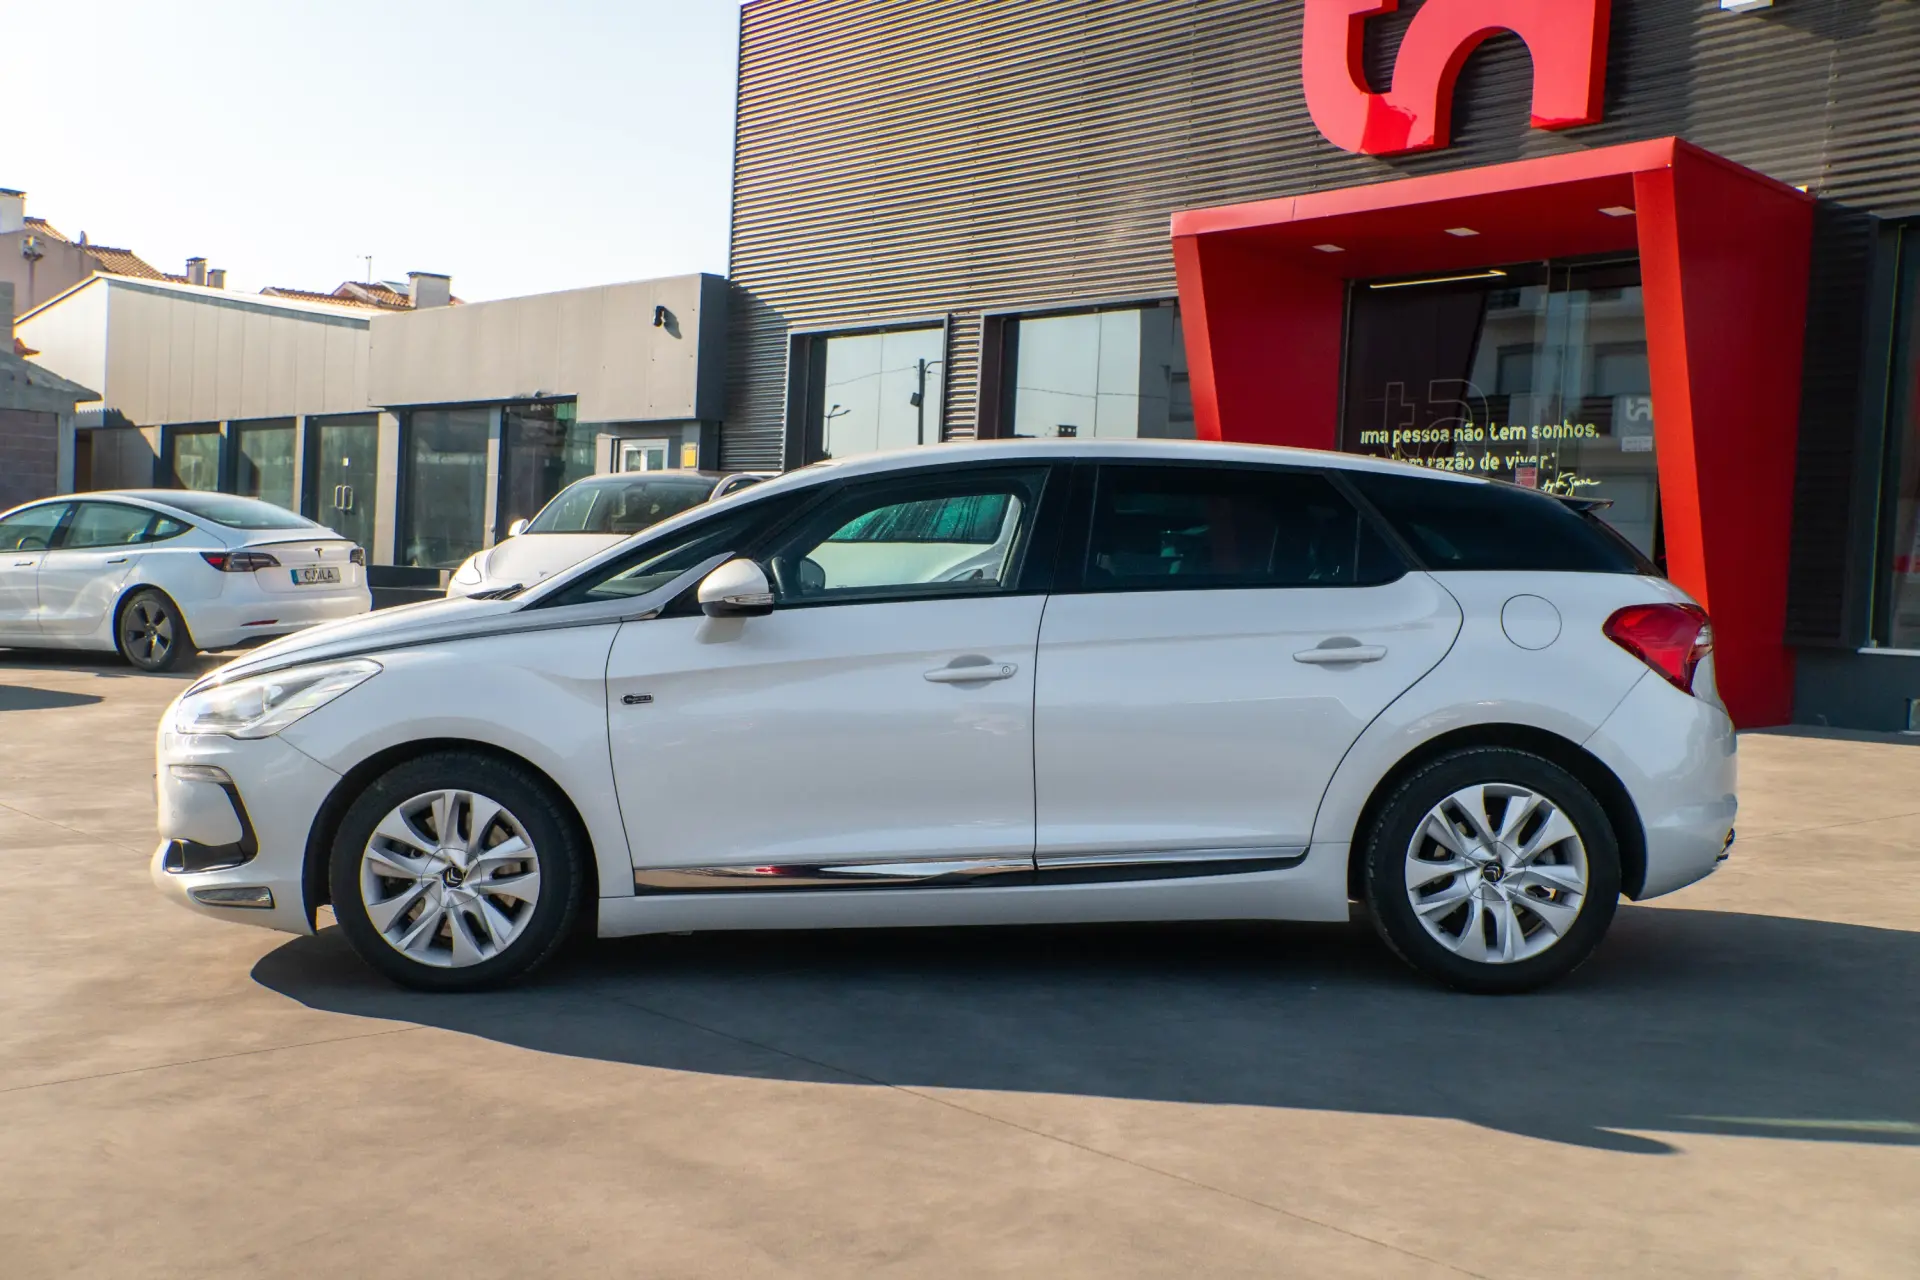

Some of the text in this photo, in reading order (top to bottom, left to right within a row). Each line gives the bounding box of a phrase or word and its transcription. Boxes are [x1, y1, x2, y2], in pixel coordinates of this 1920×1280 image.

[1393, 428, 1449, 448] pessoa
[1454, 422, 1484, 442] não
[1490, 422, 1527, 441] tem
[1427, 451, 1475, 472] razão
[1480, 451, 1500, 471] de
